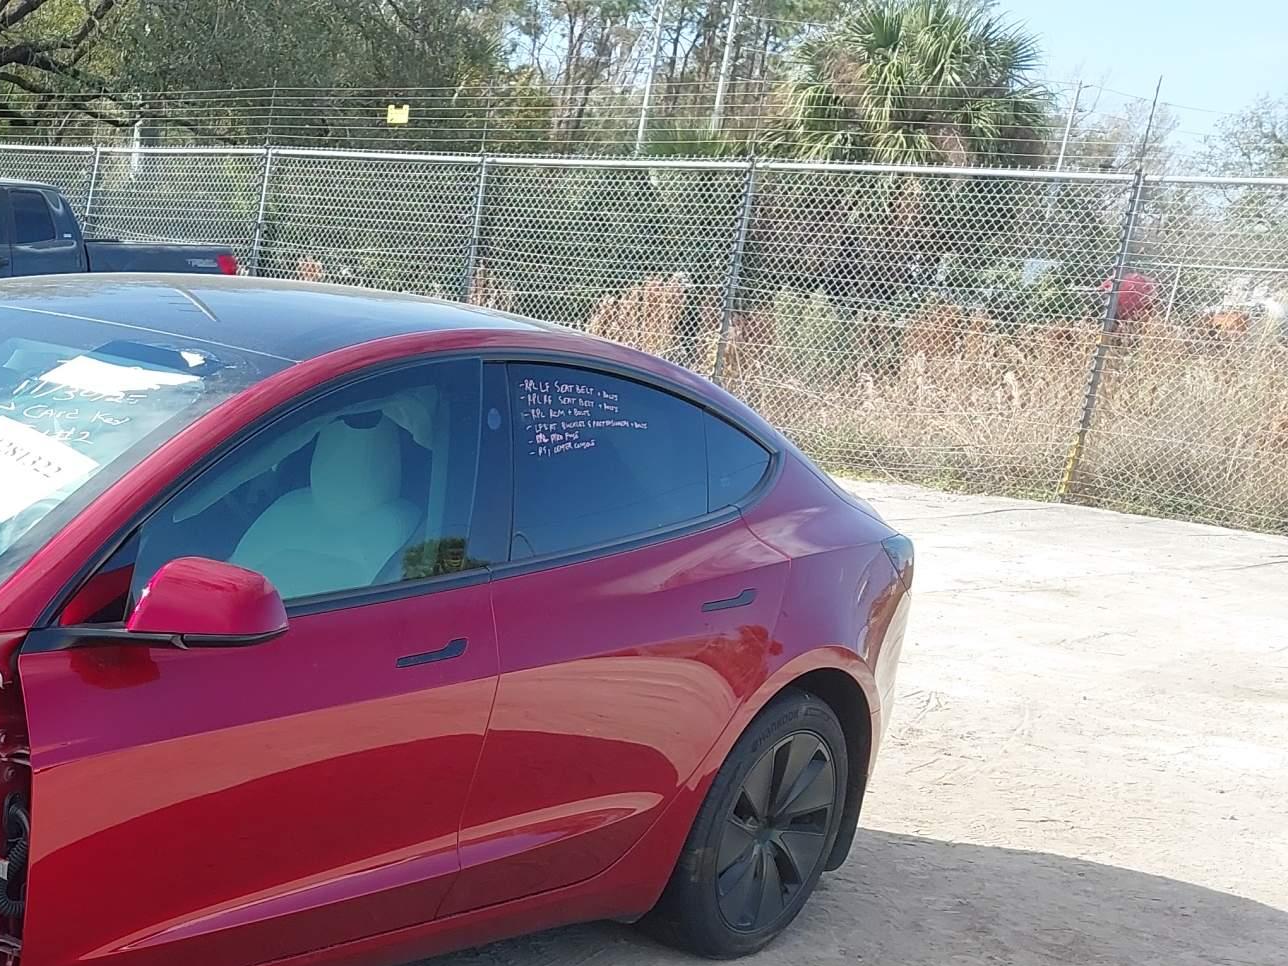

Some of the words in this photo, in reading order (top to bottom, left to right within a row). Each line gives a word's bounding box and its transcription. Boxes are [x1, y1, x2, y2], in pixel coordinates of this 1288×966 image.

[554, 380, 575, 393] SEAT
[575, 384, 595, 396] BELT
[558, 395, 577, 405] SEAT
